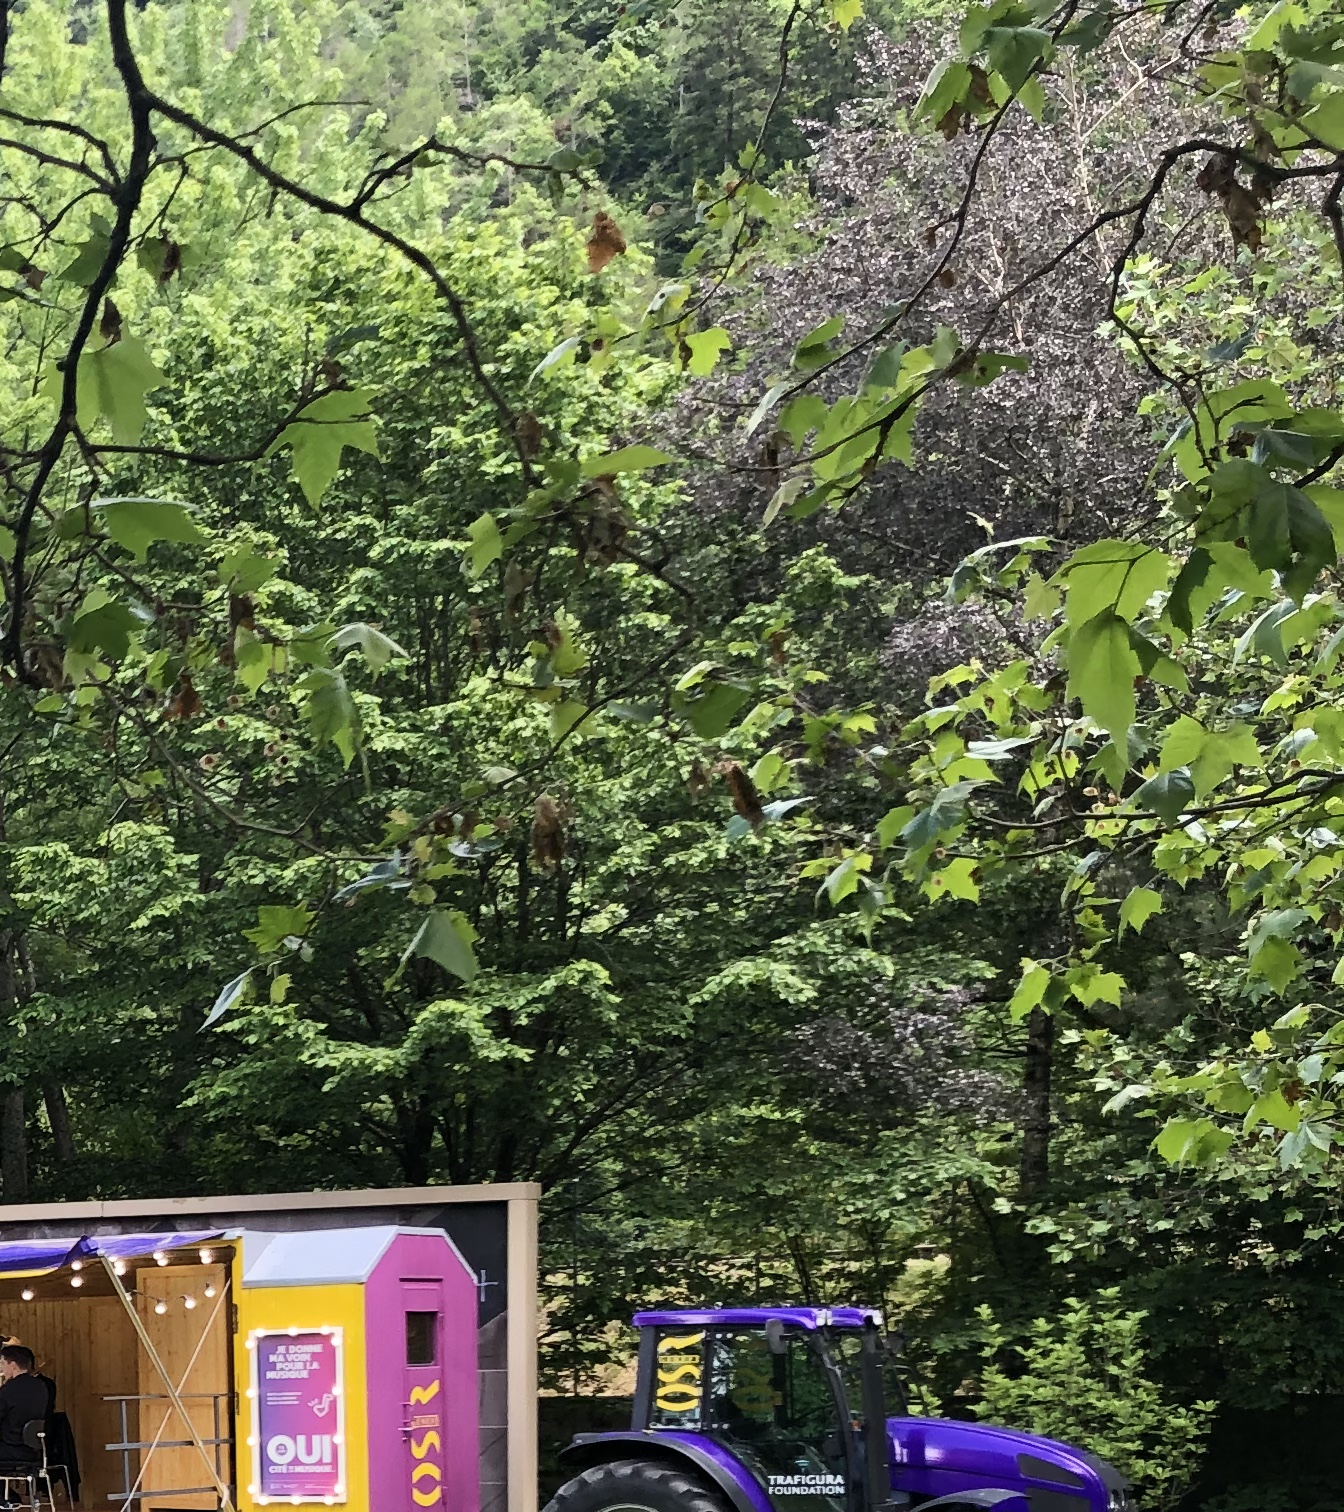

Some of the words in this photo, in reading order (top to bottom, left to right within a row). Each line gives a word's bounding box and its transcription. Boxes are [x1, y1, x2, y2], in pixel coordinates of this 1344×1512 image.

[288, 1344, 324, 1354] DONNE
[269, 1354, 285, 1362] MA
[276, 1362, 305, 1370] POUR
[306, 1361, 320, 1369] LA
[266, 1370, 310, 1379] MUSIQUE
[410, 1379, 442, 1507] OSR
[266, 1434, 332, 1465] OUI
[768, 1475, 846, 1485] TRAFIGURA
[768, 1486, 846, 1495] FOUNDATION
